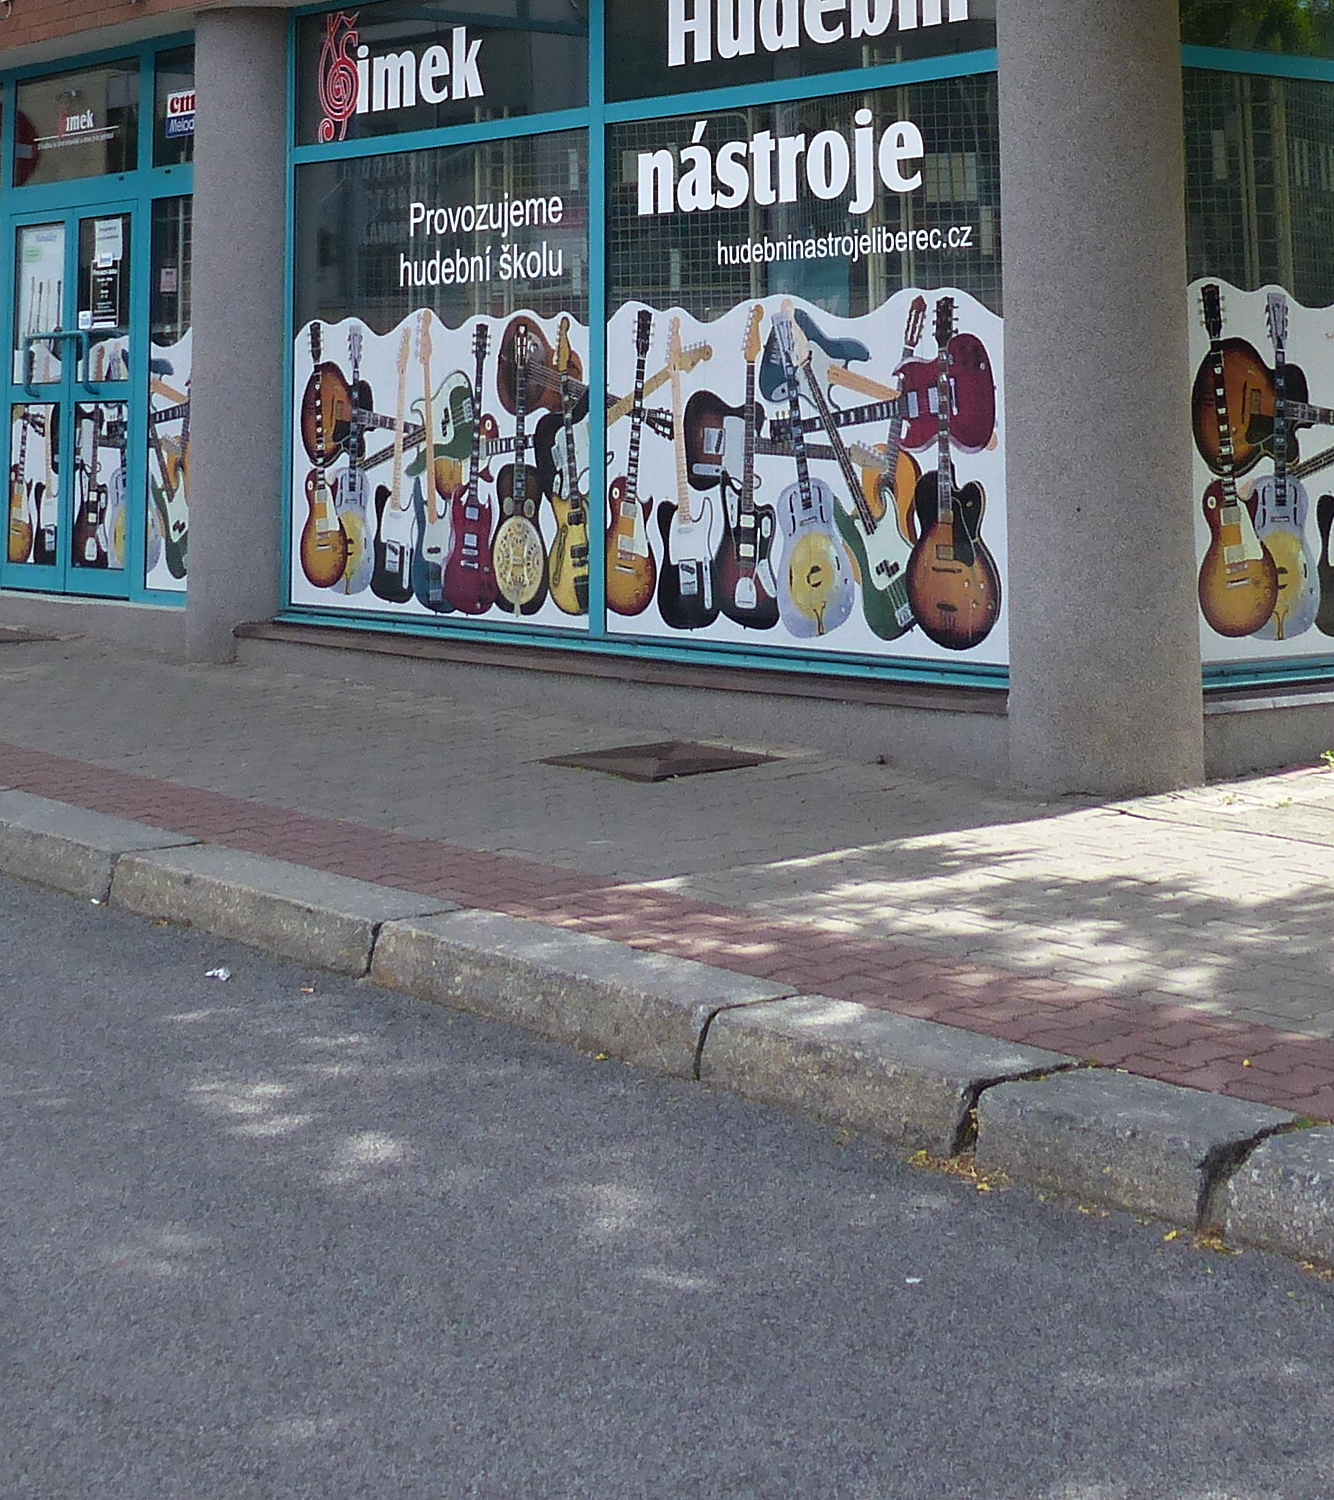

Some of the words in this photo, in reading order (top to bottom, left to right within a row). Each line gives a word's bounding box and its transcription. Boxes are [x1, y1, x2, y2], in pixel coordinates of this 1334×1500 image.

[318, 11, 484, 144] Šimek
[637, 108, 925, 216] nástroje
[409, 192, 564, 238] Provozujeme
[399, 245, 492, 287] hudební
[499, 240, 563, 280] školu
[717, 225, 974, 266] hudebninastrojeliberec.cz
